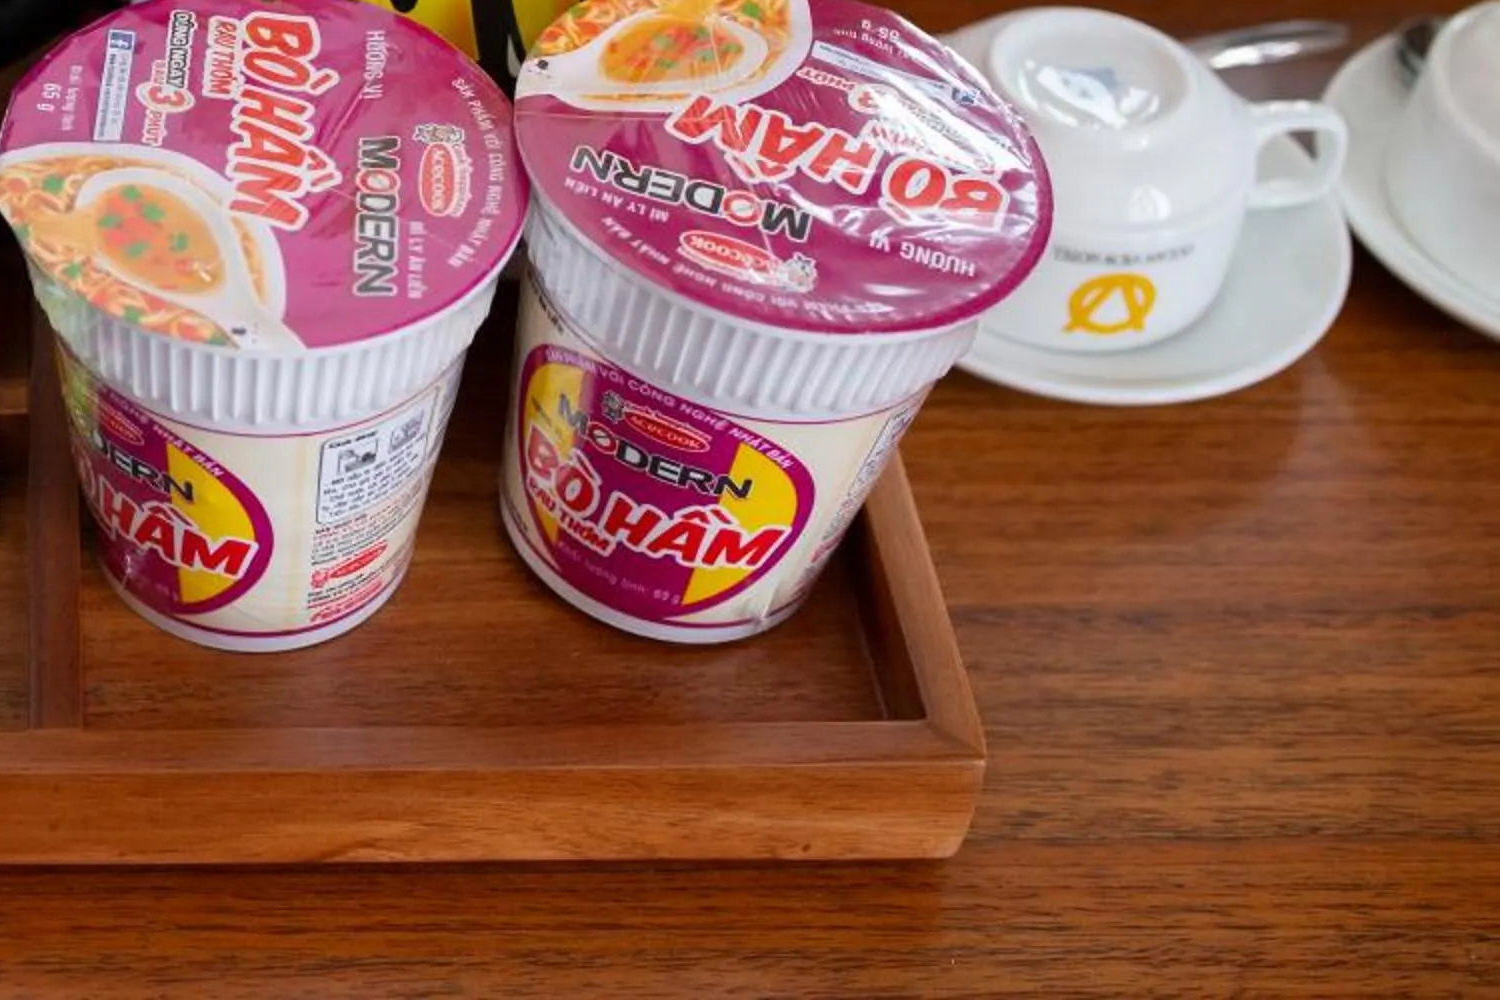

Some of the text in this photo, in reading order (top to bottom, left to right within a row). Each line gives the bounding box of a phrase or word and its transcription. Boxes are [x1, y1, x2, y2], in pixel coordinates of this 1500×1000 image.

[148, 85, 186, 108] 3
[228, 13, 337, 228] BÒ HẦM
[357, 137, 400, 295] MODERN
[572, 147, 811, 241] MODERN
[558, 392, 752, 499] MODERN
[102, 477, 254, 577] HẦM
[604, 493, 789, 567] HẦM
